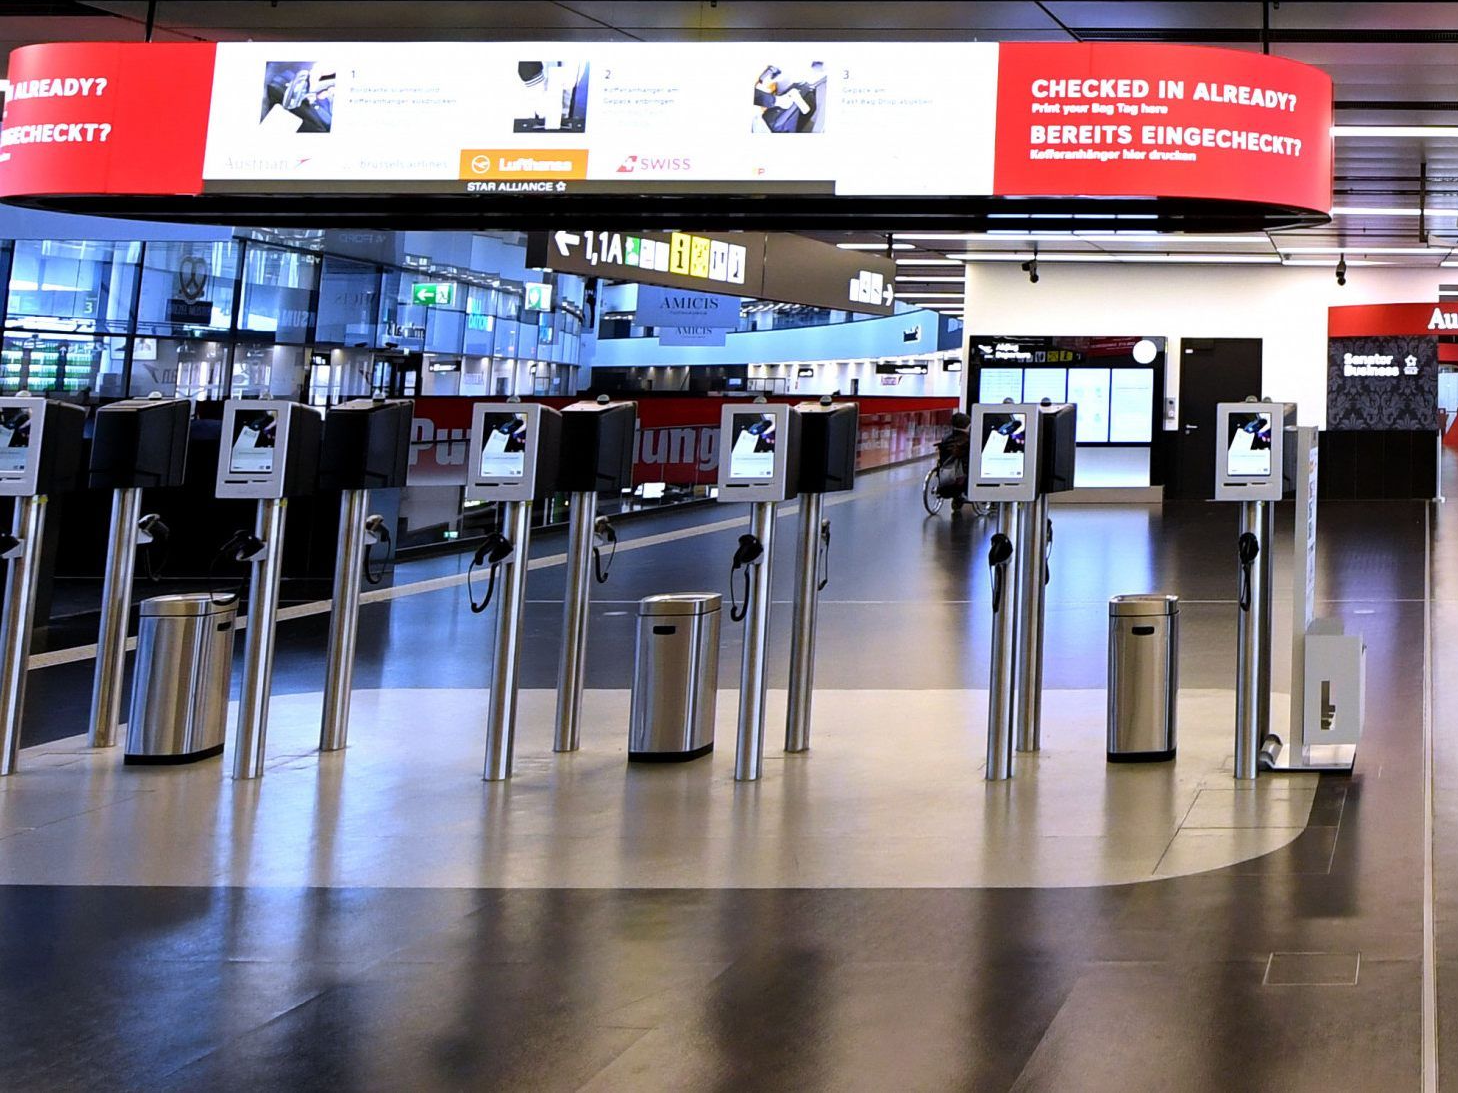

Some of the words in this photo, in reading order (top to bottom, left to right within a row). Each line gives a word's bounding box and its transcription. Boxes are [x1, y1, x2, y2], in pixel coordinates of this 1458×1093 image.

[604, 69, 611, 79] 2
[843, 69, 850, 79] 3
[14, 78, 107, 100] ALREADY?
[1031, 79, 1149, 98] CHECKED
[1158, 80, 1184, 99] IN
[1192, 81, 1297, 112] ALREADY?
[1032, 103, 1060, 114] Print
[1063, 104, 1090, 115] your
[1092, 103, 1114, 115] Bag
[1116, 103, 1139, 115] Tag
[1141, 103, 1168, 114] here
[1030, 125, 1132, 144] BEREITS
[1141, 126, 1302, 157] EINGECHECKT?
[640, 159, 692, 171] SWISS
[467, 181, 496, 192] STAR
[498, 181, 553, 192] ALLIANCE
[660, 296, 719, 309] AMICIS
[675, 327, 712, 336] AMICIS
[1344, 353, 1394, 365] Senator
[1344, 364, 1400, 377] Business
